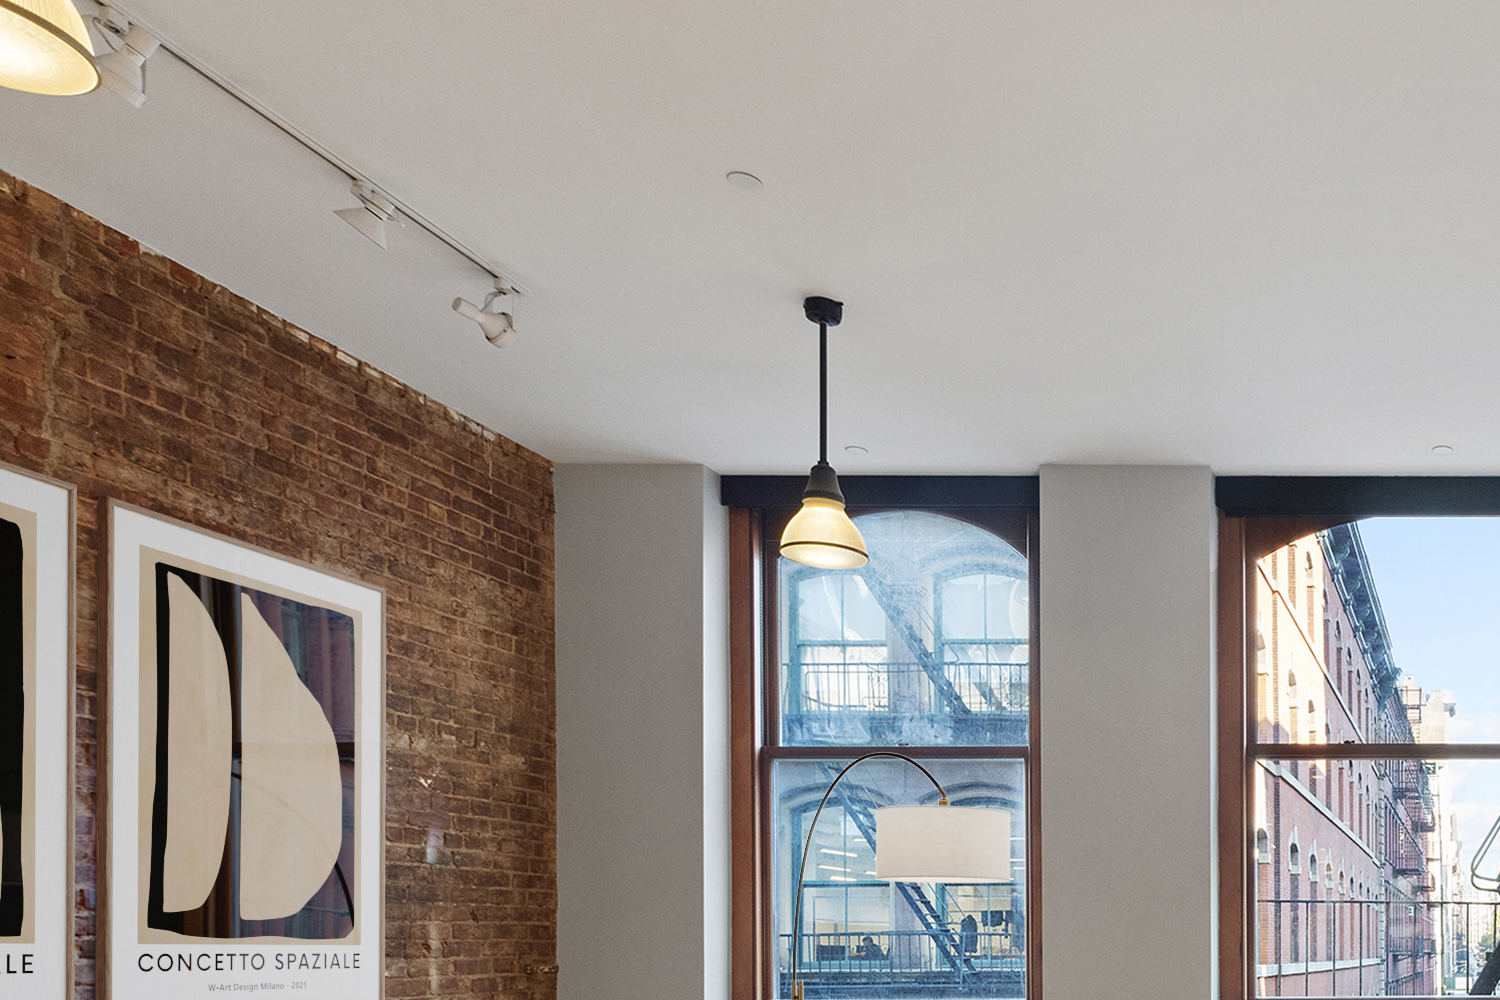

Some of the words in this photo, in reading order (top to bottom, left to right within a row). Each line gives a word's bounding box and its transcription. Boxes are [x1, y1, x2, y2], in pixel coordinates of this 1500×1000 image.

[0, 953, 34, 975] LE
[138, 953, 265, 972] CONCETTO
[275, 952, 361, 970] SPAZIALE
[233, 982, 258, 993] Design
[260, 981, 285, 991] Milano
[291, 981, 307, 990] 2021
